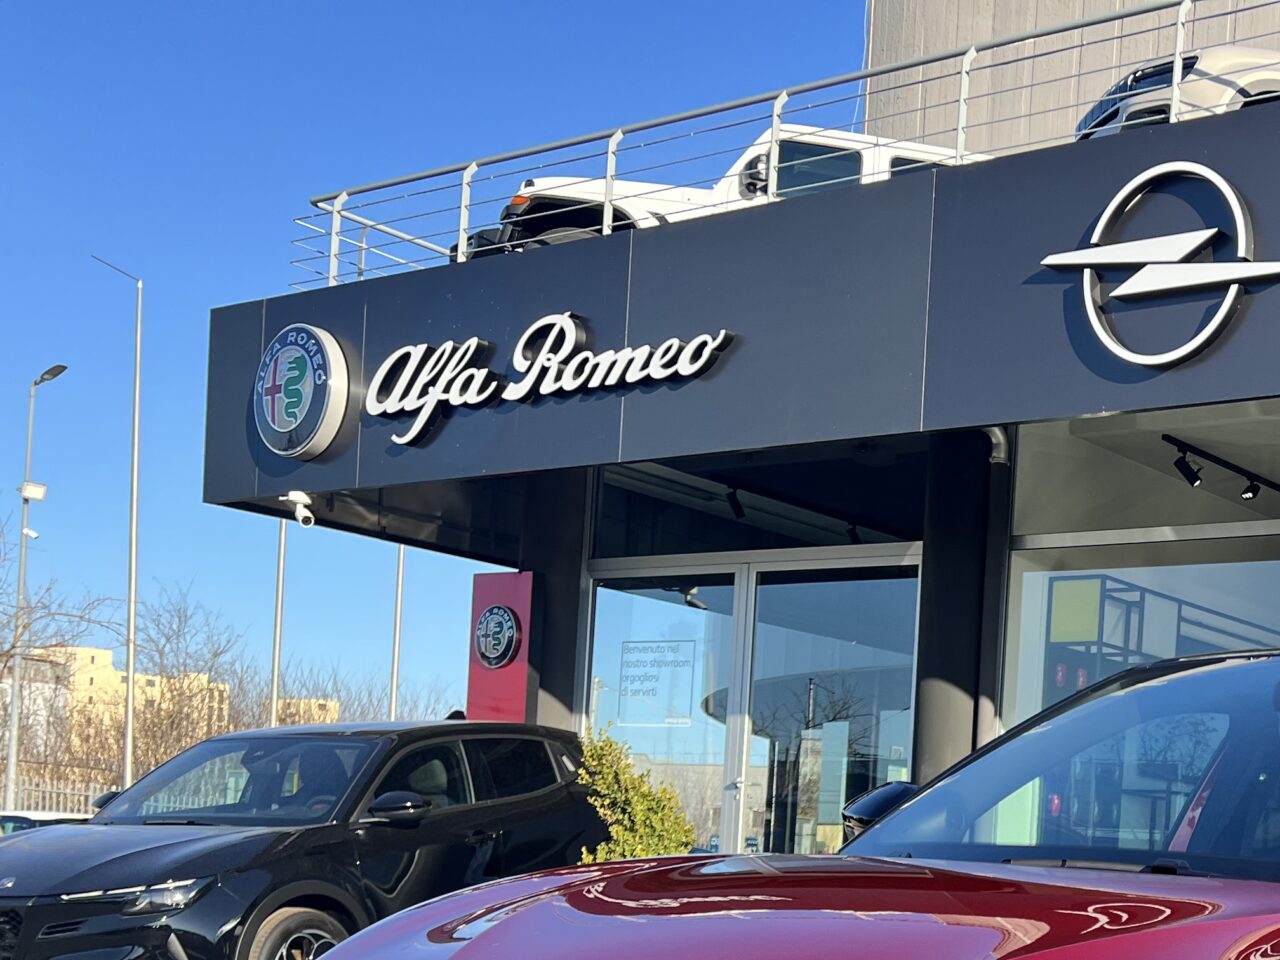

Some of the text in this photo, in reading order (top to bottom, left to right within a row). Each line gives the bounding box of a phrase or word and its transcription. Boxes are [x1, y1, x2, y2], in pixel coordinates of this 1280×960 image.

[257, 331, 327, 394] ALFA ROMEO
[365, 311, 726, 444] Alfa Romeo
